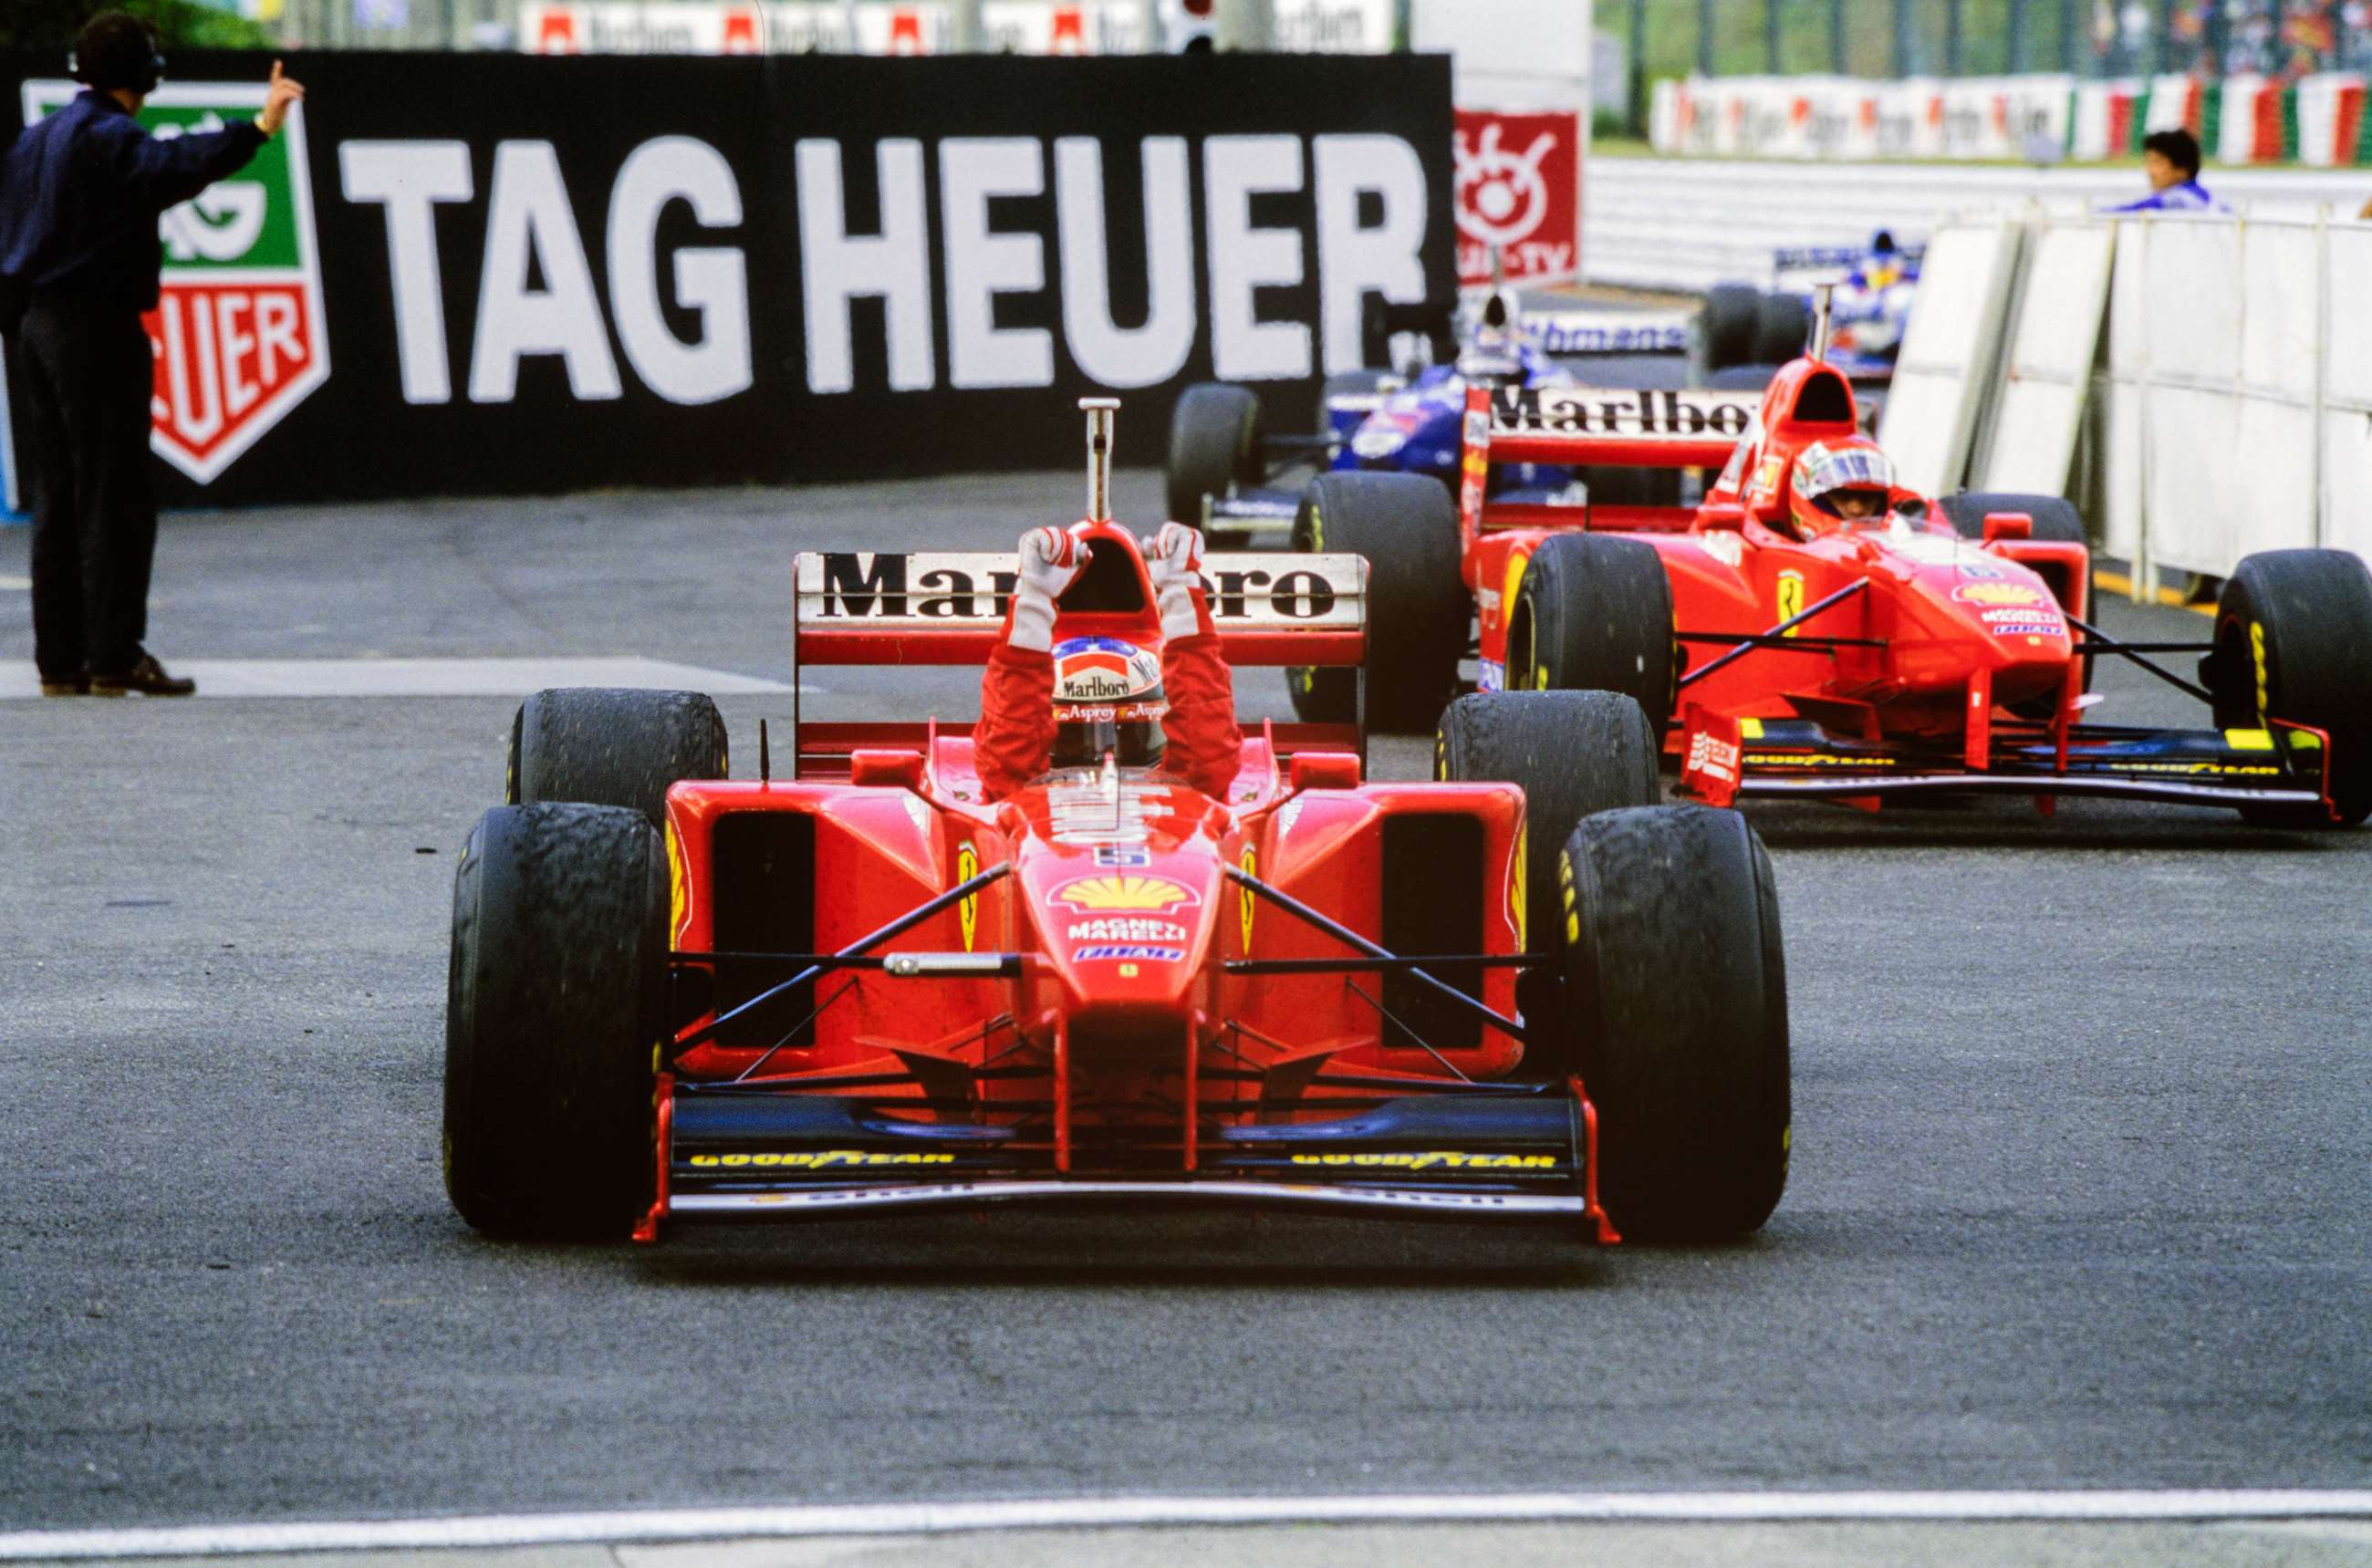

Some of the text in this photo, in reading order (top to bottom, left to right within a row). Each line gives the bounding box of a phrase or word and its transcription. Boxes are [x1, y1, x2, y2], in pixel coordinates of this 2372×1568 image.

[338, 133, 1429, 405] TAG HEUER
[150, 290, 305, 443] UER
[1490, 389, 1757, 433] Marlbo
[1064, 676, 1129, 697] Marlboro
[1069, 704, 1116, 722] Asprey
[690, 1150, 955, 1168] GOODYEAR
[1291, 1151, 1555, 1170] GOODYEAR
